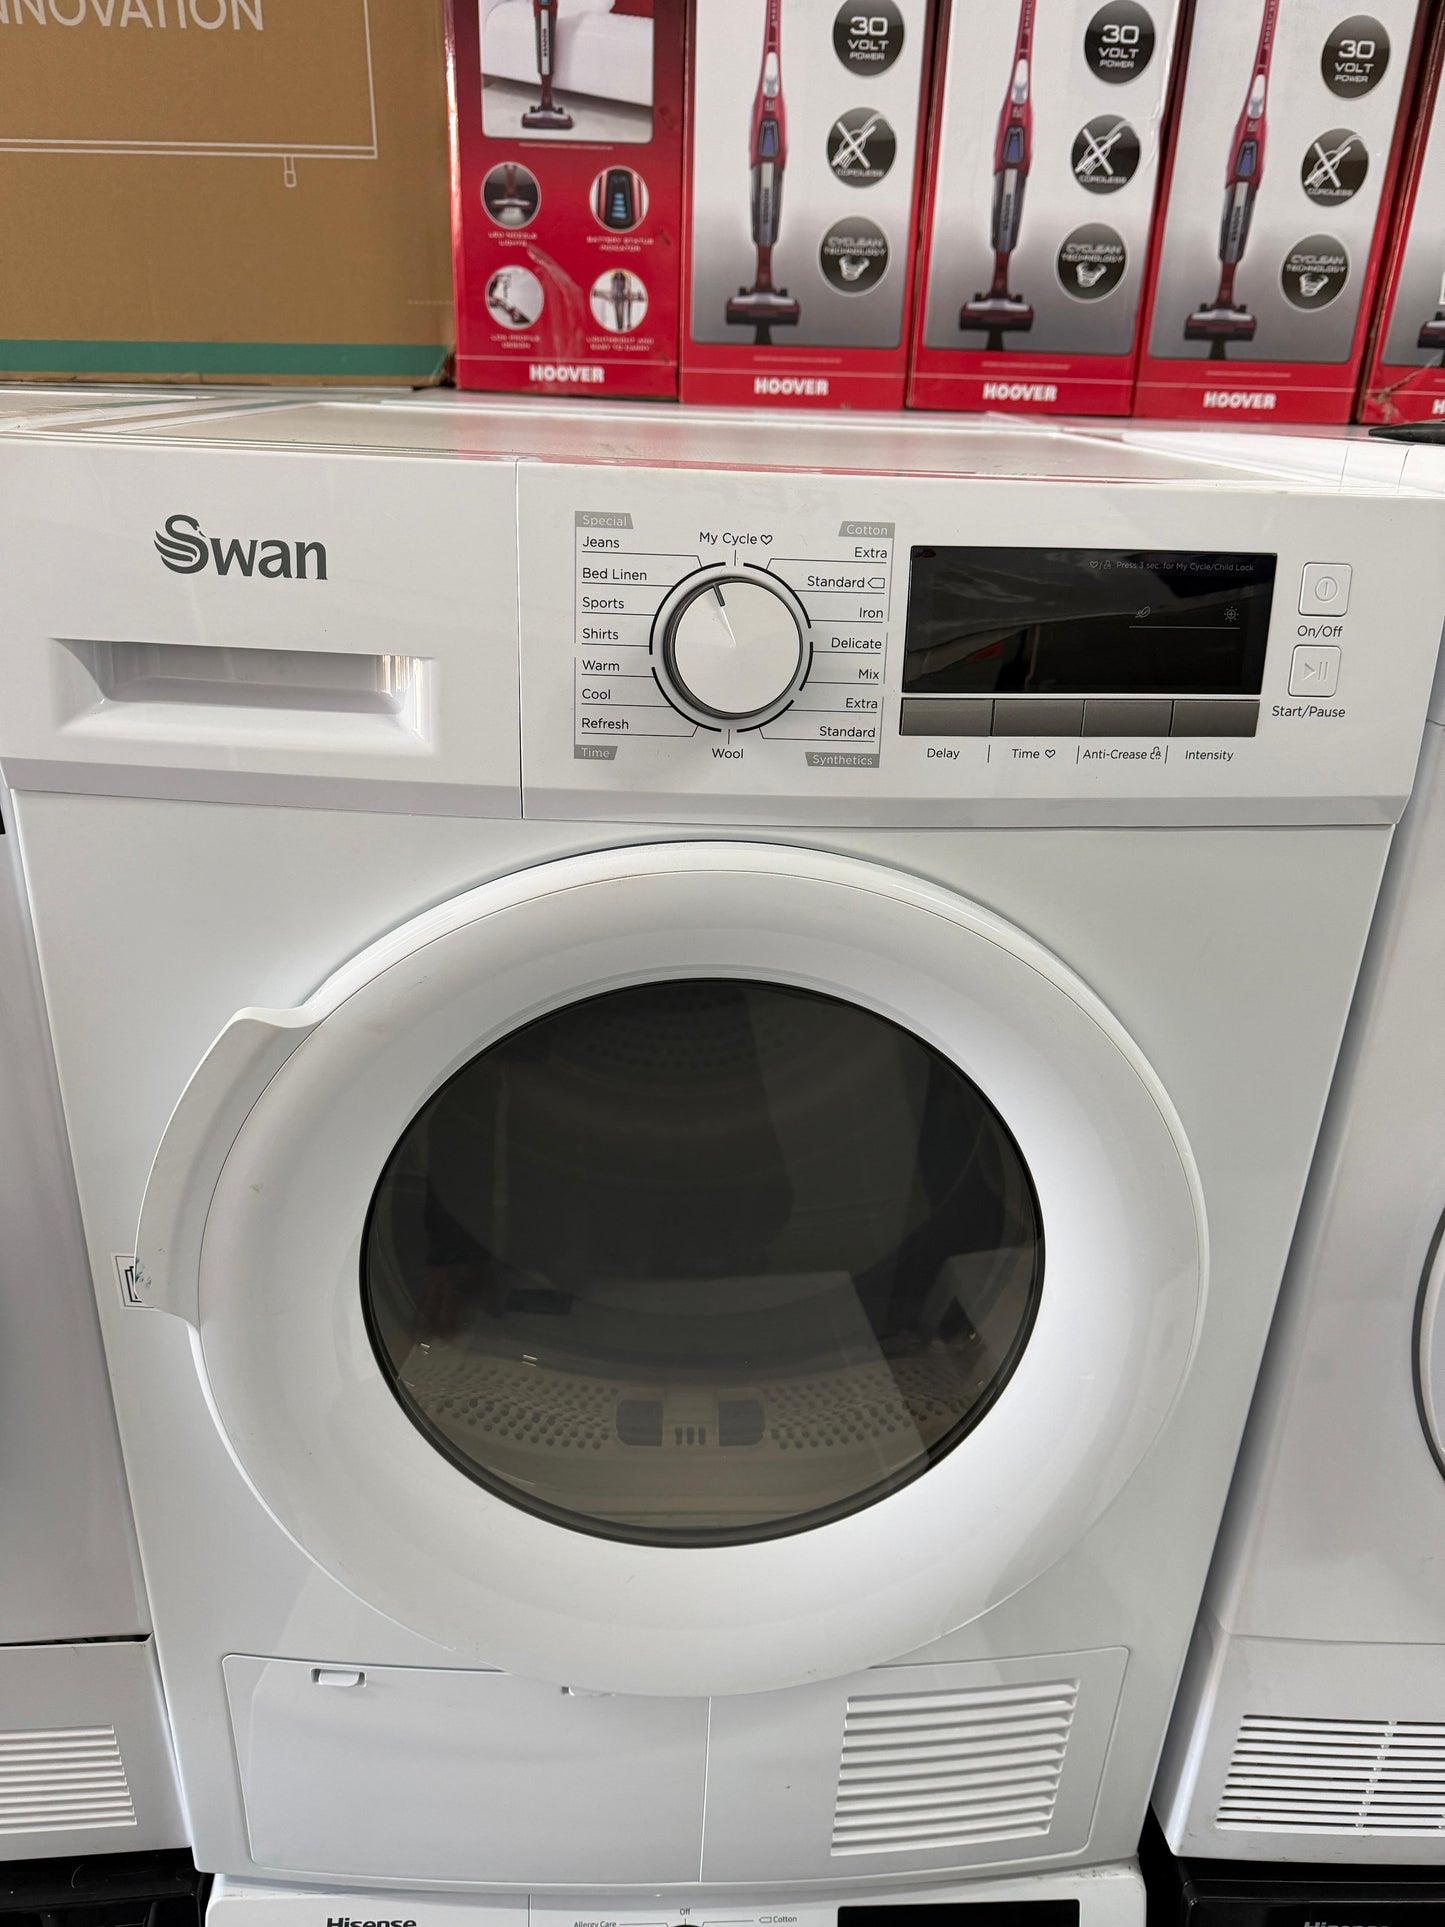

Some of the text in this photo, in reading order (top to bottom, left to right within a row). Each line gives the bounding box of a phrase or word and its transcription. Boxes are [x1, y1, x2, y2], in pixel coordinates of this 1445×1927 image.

[850, 16, 888, 36] 30
[1102, 24, 1139, 44] 30
[848, 39, 889, 50] VOLT
[1338, 40, 1375, 59] 30
[849, 52, 885, 61] POWER
[1098, 47, 1139, 59] VOLT
[1099, 60, 1135, 69] POWER
[1334, 62, 1374, 73] VOLT
[1334, 75, 1369, 83] POWER
[1307, 188, 1353, 197] CORDLESS
[1291, 254, 1345, 265] CYCLEAN
[1286, 264, 1346, 274] TECHNOLOGY
[529, 364, 605, 383] HOOVER
[754, 377, 829, 395] HOOVER
[982, 383, 1057, 401] HOOVER
[1203, 391, 1277, 410] HOOVER
[583, 515, 627, 528] Special
[847, 524, 888, 536] Cotton
[582, 537, 620, 549] Jeans
[699, 532, 758, 548] My Cycle
[153, 514, 328, 580] Swan
[854, 547, 888, 559] Extra
[1116, 561, 1137, 569] Press
[1163, 562, 1173, 570] for
[1176, 563, 1188, 571] My
[1190, 562, 1233, 572] Cycle/Child
[1235, 563, 1254, 572] Lock
[583, 568, 647, 581] Bed Linen
[807, 575, 865, 588] Standard
[582, 597, 625, 611] Sports
[859, 607, 884, 619] Iron
[582, 628, 619, 640] Shirts
[1297, 625, 1343, 639] On/Off
[831, 637, 882, 650] Delicate
[582, 660, 620, 672] Warm
[858, 668, 880, 680] Mix
[582, 688, 611, 700] Cool
[845, 698, 878, 710] Extra
[1272, 705, 1346, 720] Start/Pause
[581, 717, 629, 730] Refresh
[819, 726, 876, 738] Standard
[581, 748, 610, 759] Time
[712, 748, 744, 759] Wool
[926, 748, 960, 761] Delay
[1012, 748, 1040, 760] Time
[1083, 748, 1147, 761] Anti-Crease
[1185, 749, 1233, 763] Intensity
[812, 755, 873, 768] Synthetics
[680, 1908, 690, 1916] Off
[773, 1916, 798, 1924] Cotton
